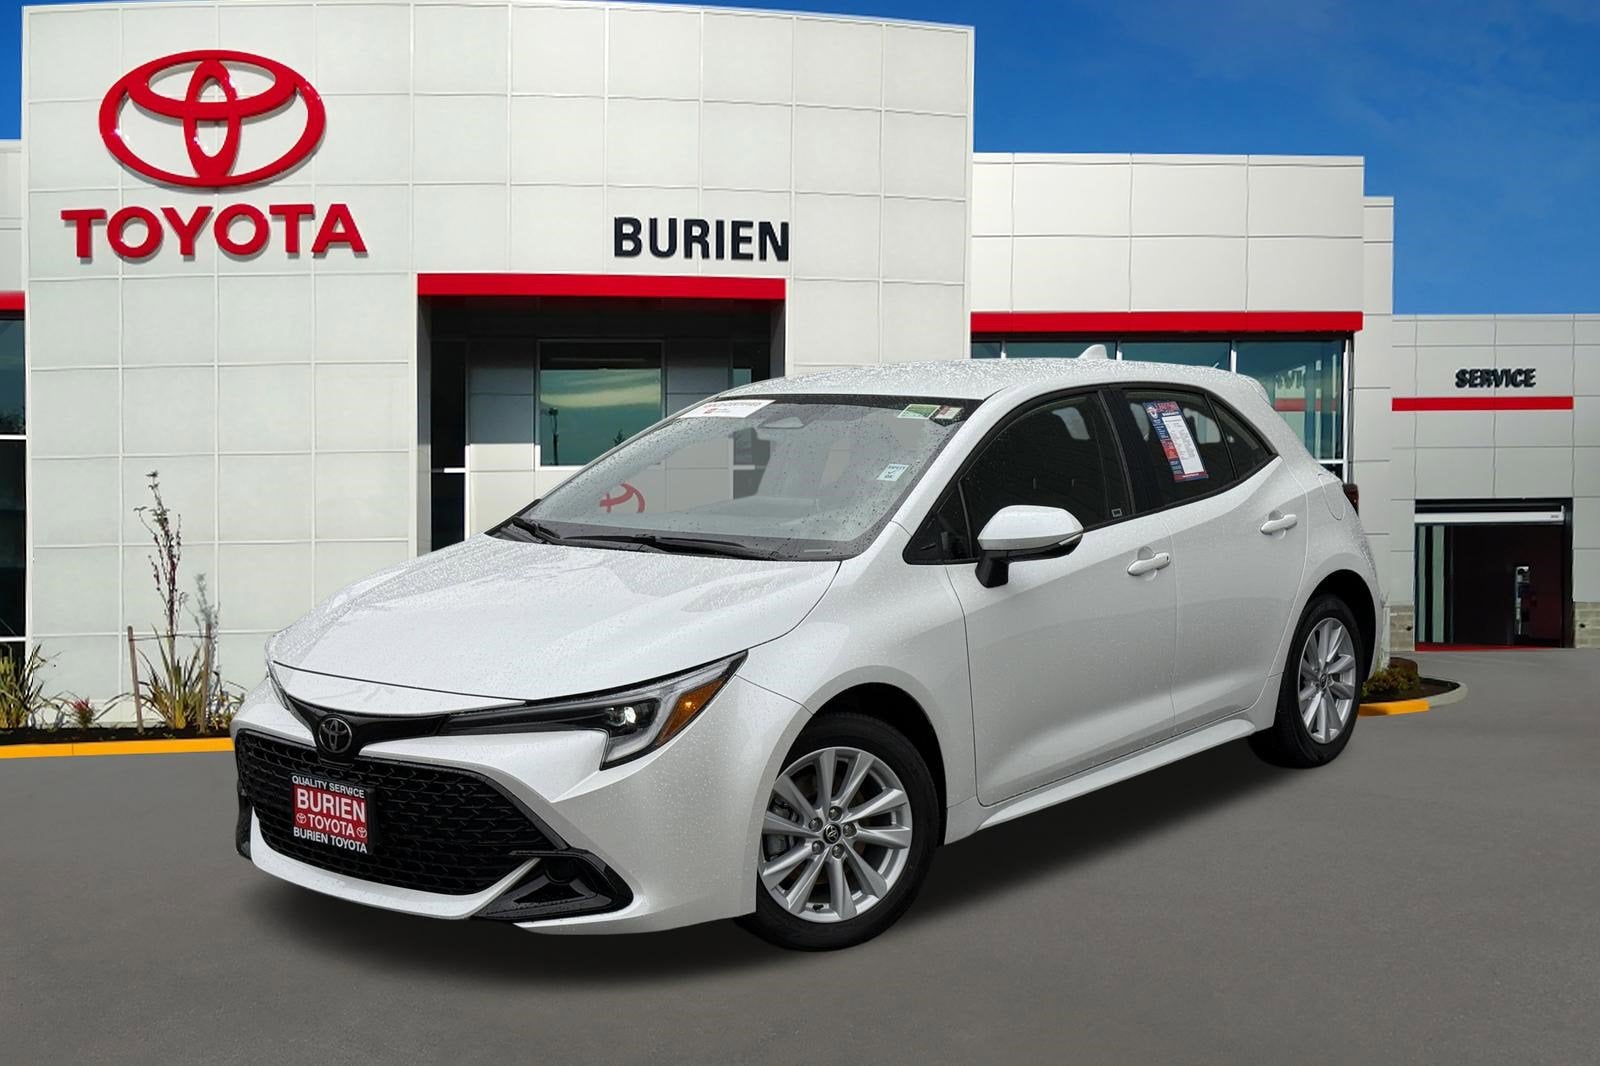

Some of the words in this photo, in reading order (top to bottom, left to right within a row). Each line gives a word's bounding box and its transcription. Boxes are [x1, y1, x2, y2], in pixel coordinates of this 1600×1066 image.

[61, 204, 368, 259] TOYOTA
[614, 217, 790, 262] BURIEN
[1455, 368, 1536, 388] SERVICE
[292, 775, 327, 790] QUALITY
[329, 782, 365, 799] SERVICE
[297, 788, 366, 822] BURIEN
[308, 814, 355, 837] TOYOTA
[293, 827, 328, 844] BURIEN
[330, 835, 368, 854] TOYOTA
